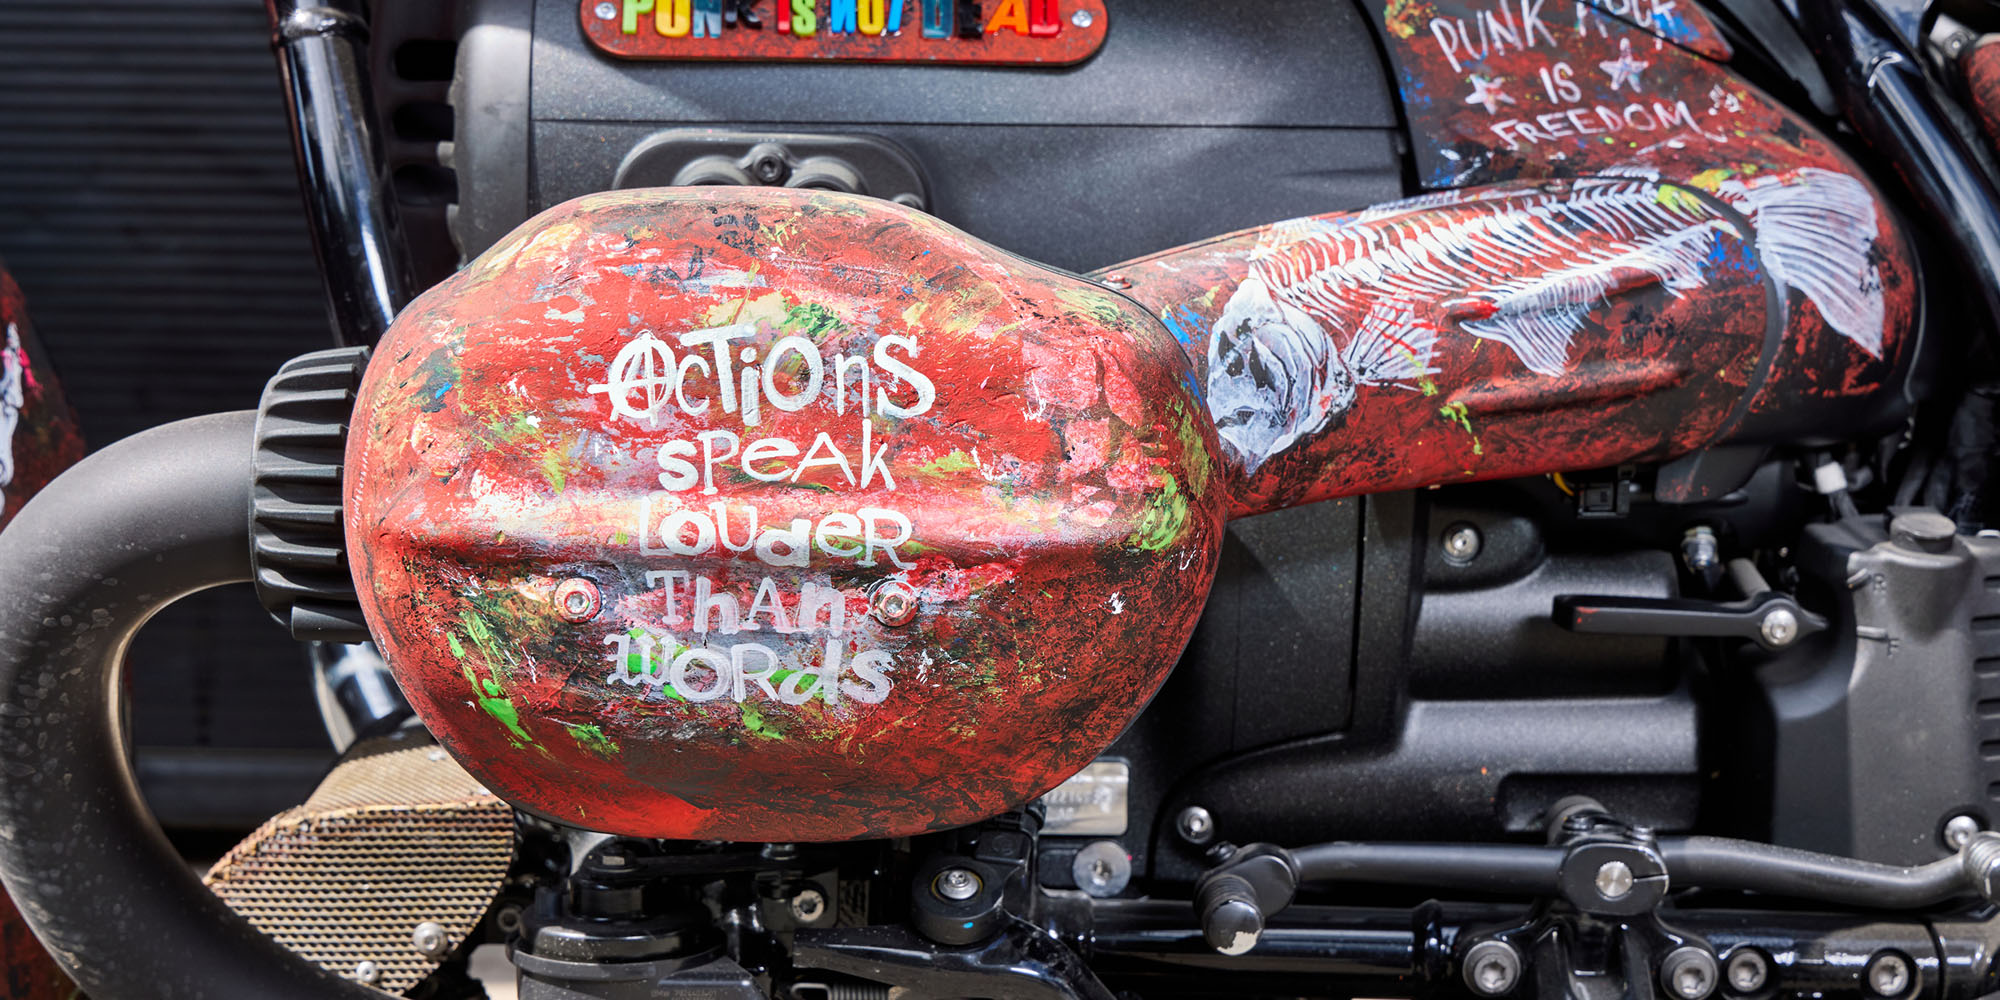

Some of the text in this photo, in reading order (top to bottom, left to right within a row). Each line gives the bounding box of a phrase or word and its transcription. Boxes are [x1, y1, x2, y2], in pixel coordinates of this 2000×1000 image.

[622, 0, 763, 38] PUNK
[777, 0, 817, 36] IS
[1429, 0, 1557, 73] PUNK
[1539, 61, 1582, 104] IS
[1490, 100, 1704, 151] FREEDOM
